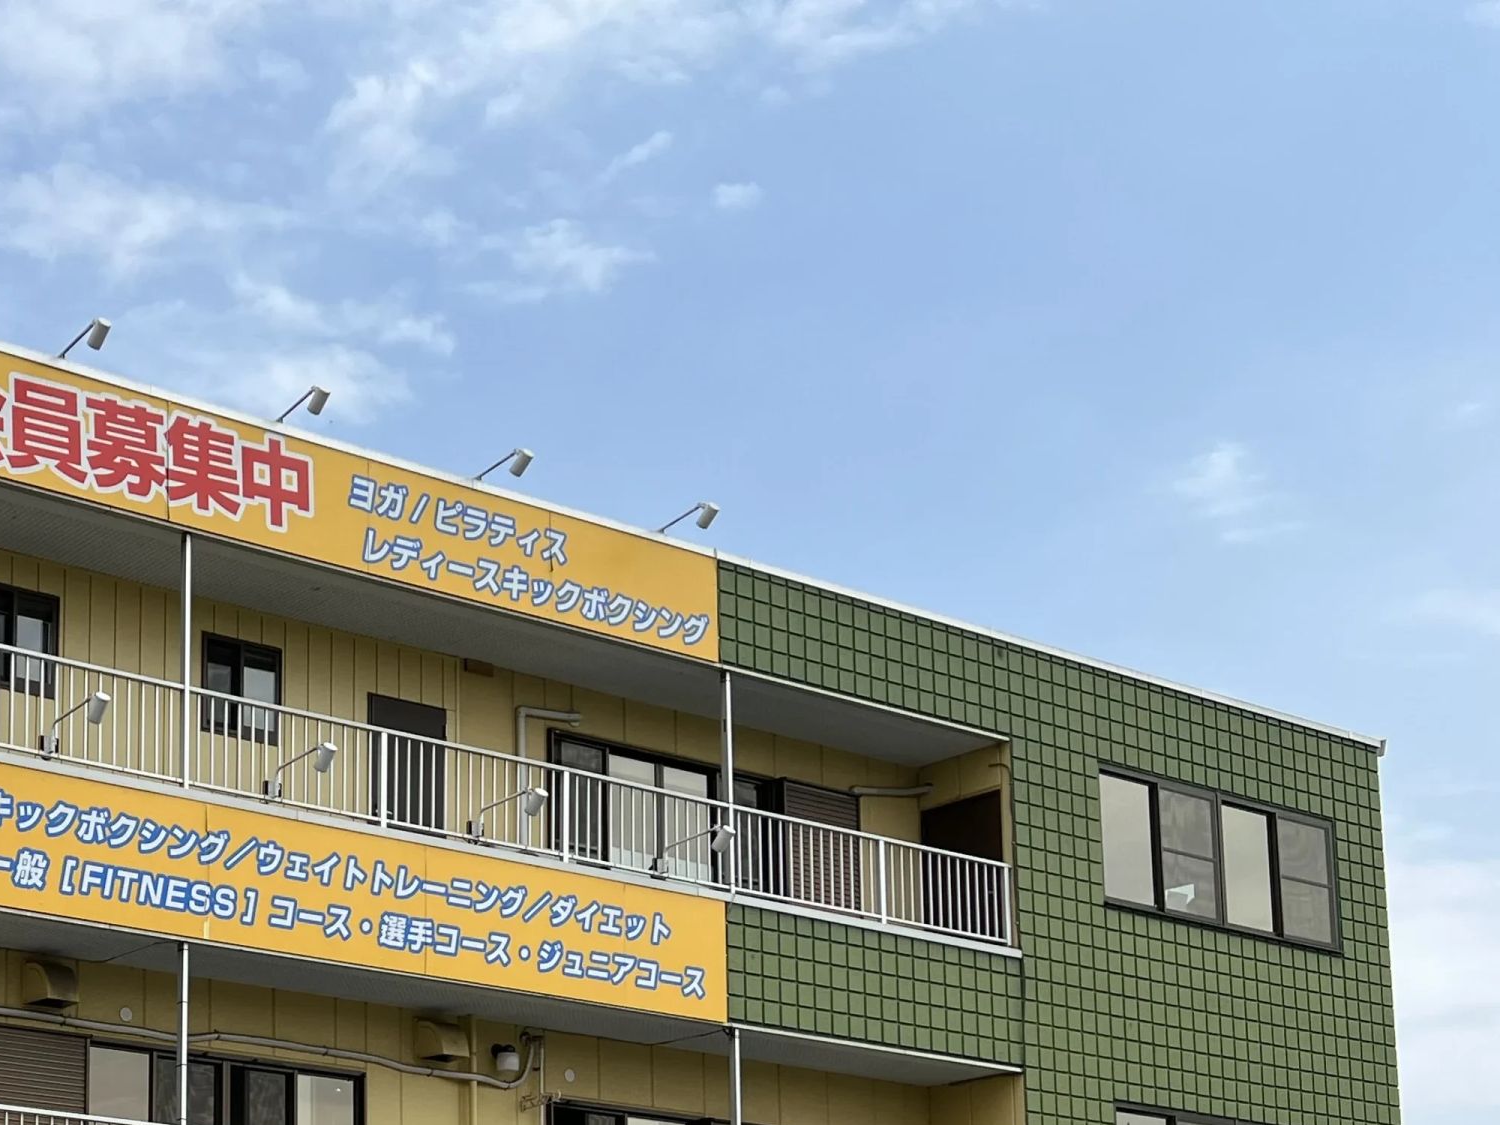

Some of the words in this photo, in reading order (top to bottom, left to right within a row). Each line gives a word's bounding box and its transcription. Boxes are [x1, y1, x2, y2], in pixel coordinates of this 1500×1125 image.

[362, 528, 710, 645] レディースキックボクシング
